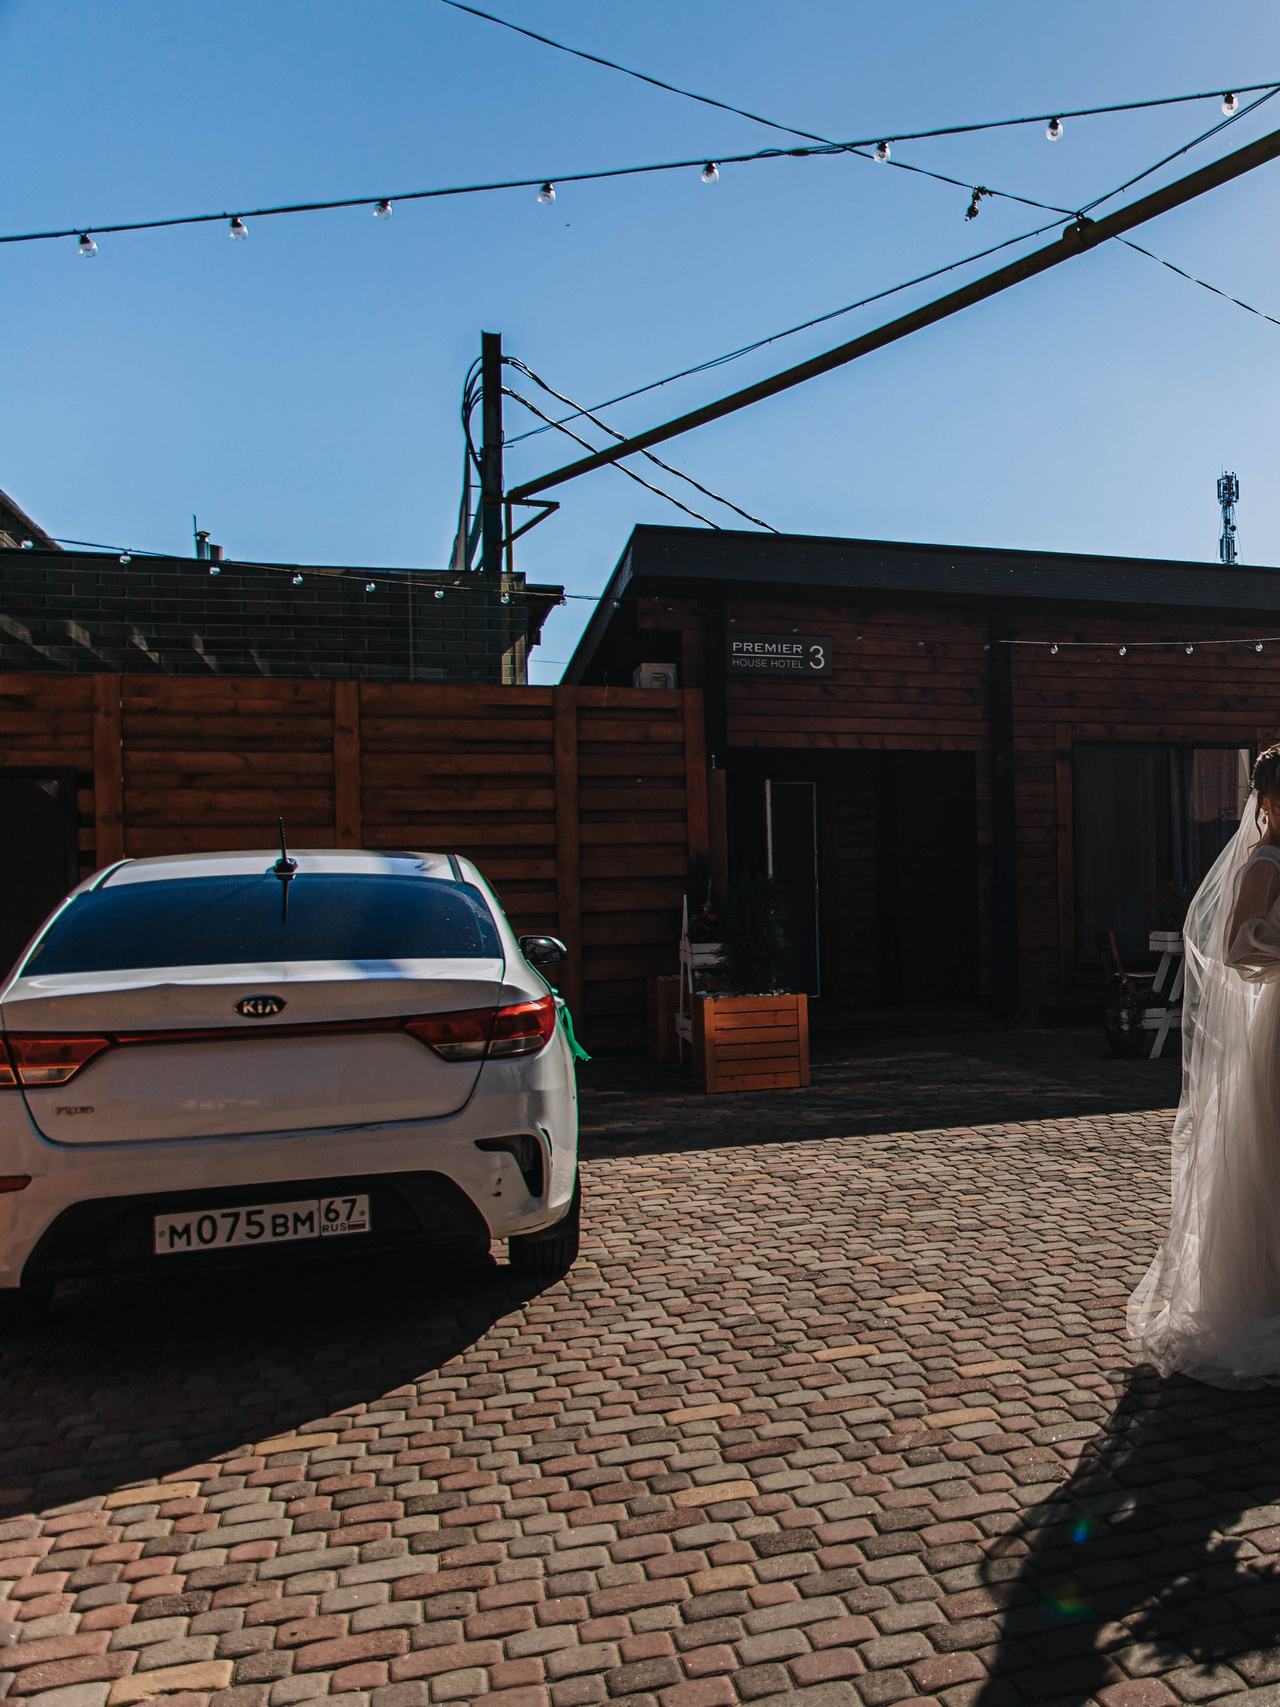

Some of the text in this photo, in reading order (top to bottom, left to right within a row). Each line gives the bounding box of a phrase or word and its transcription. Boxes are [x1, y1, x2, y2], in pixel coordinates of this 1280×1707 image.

[732, 642, 802, 653] PREMIER
[810, 645, 825, 669] 3
[732, 658, 804, 669] HOUSE HOTEL
[242, 1000, 279, 1014] KIA
[324, 1198, 358, 1223] 67
[322, 1222, 347, 1233] RUS
